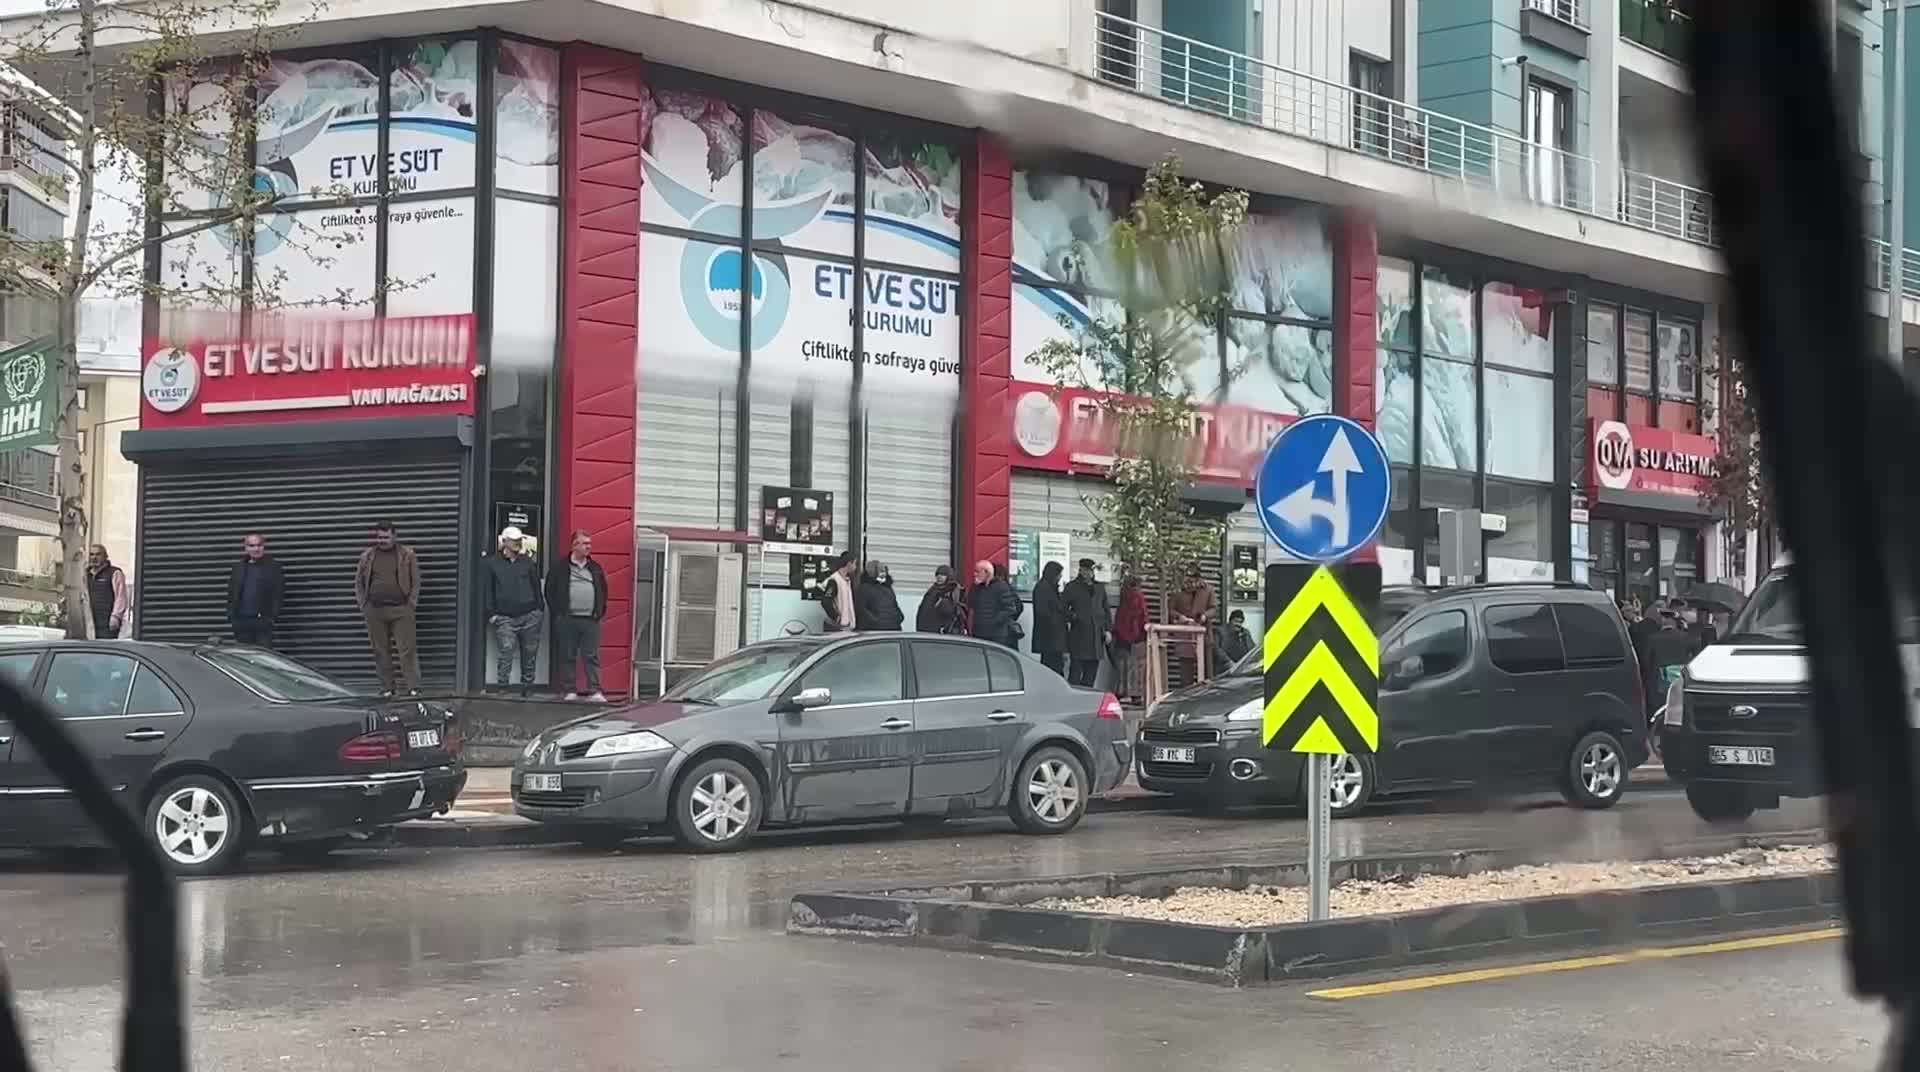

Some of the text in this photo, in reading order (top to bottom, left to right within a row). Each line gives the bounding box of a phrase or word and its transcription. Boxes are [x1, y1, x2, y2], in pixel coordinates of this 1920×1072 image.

[330, 148, 443, 179] ET VE SÜT
[320, 213, 366, 229] Çiftlikten
[368, 211, 412, 225] soraya
[815, 264, 960, 316] ET VE SÜT
[204, 343, 240, 377] ET
[242, 341, 281, 375] VE
[342, 324, 469, 369] KURUMU
[801, 340, 871, 361] Çiftlikten
[874, 351, 926, 373] sofraya
[351, 382, 467, 406] VAN MAĞAZASI
[1639, 447, 1661, 470] SU
[1734, 750, 1741, 763] S
